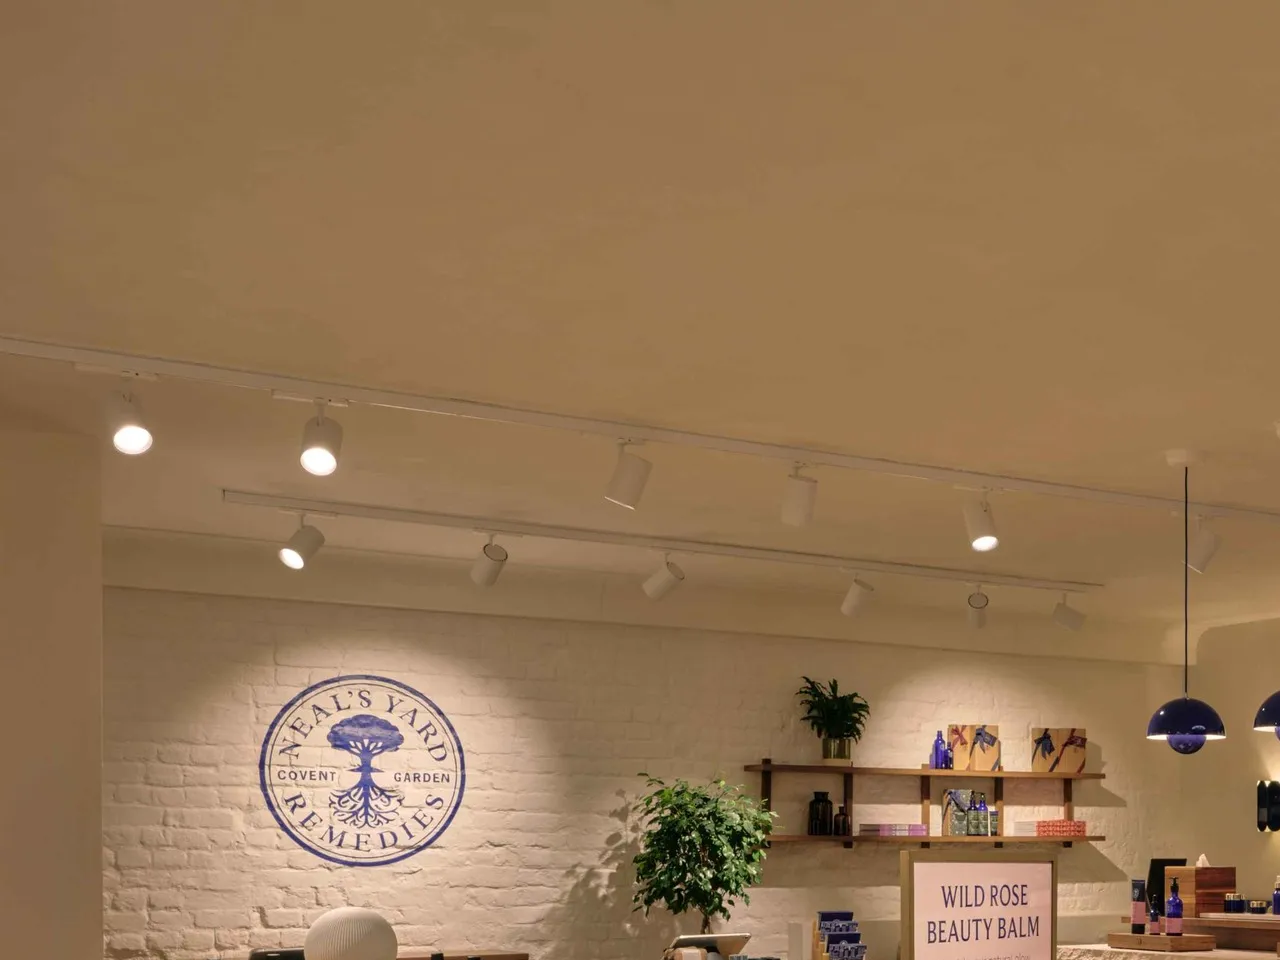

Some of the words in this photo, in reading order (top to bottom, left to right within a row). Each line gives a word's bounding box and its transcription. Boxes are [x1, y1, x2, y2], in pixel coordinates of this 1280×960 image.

[279, 689, 371, 760] NEAL'S
[385, 694, 447, 762] YARD
[277, 770, 337, 782] COVENT
[393, 772, 450, 784] GARDEN
[284, 792, 444, 852] REMEDIES
[940, 885, 985, 908] WILD
[990, 884, 1028, 907] ROSE
[927, 918, 993, 944] BEAUTY
[998, 915, 1039, 939] BALM
